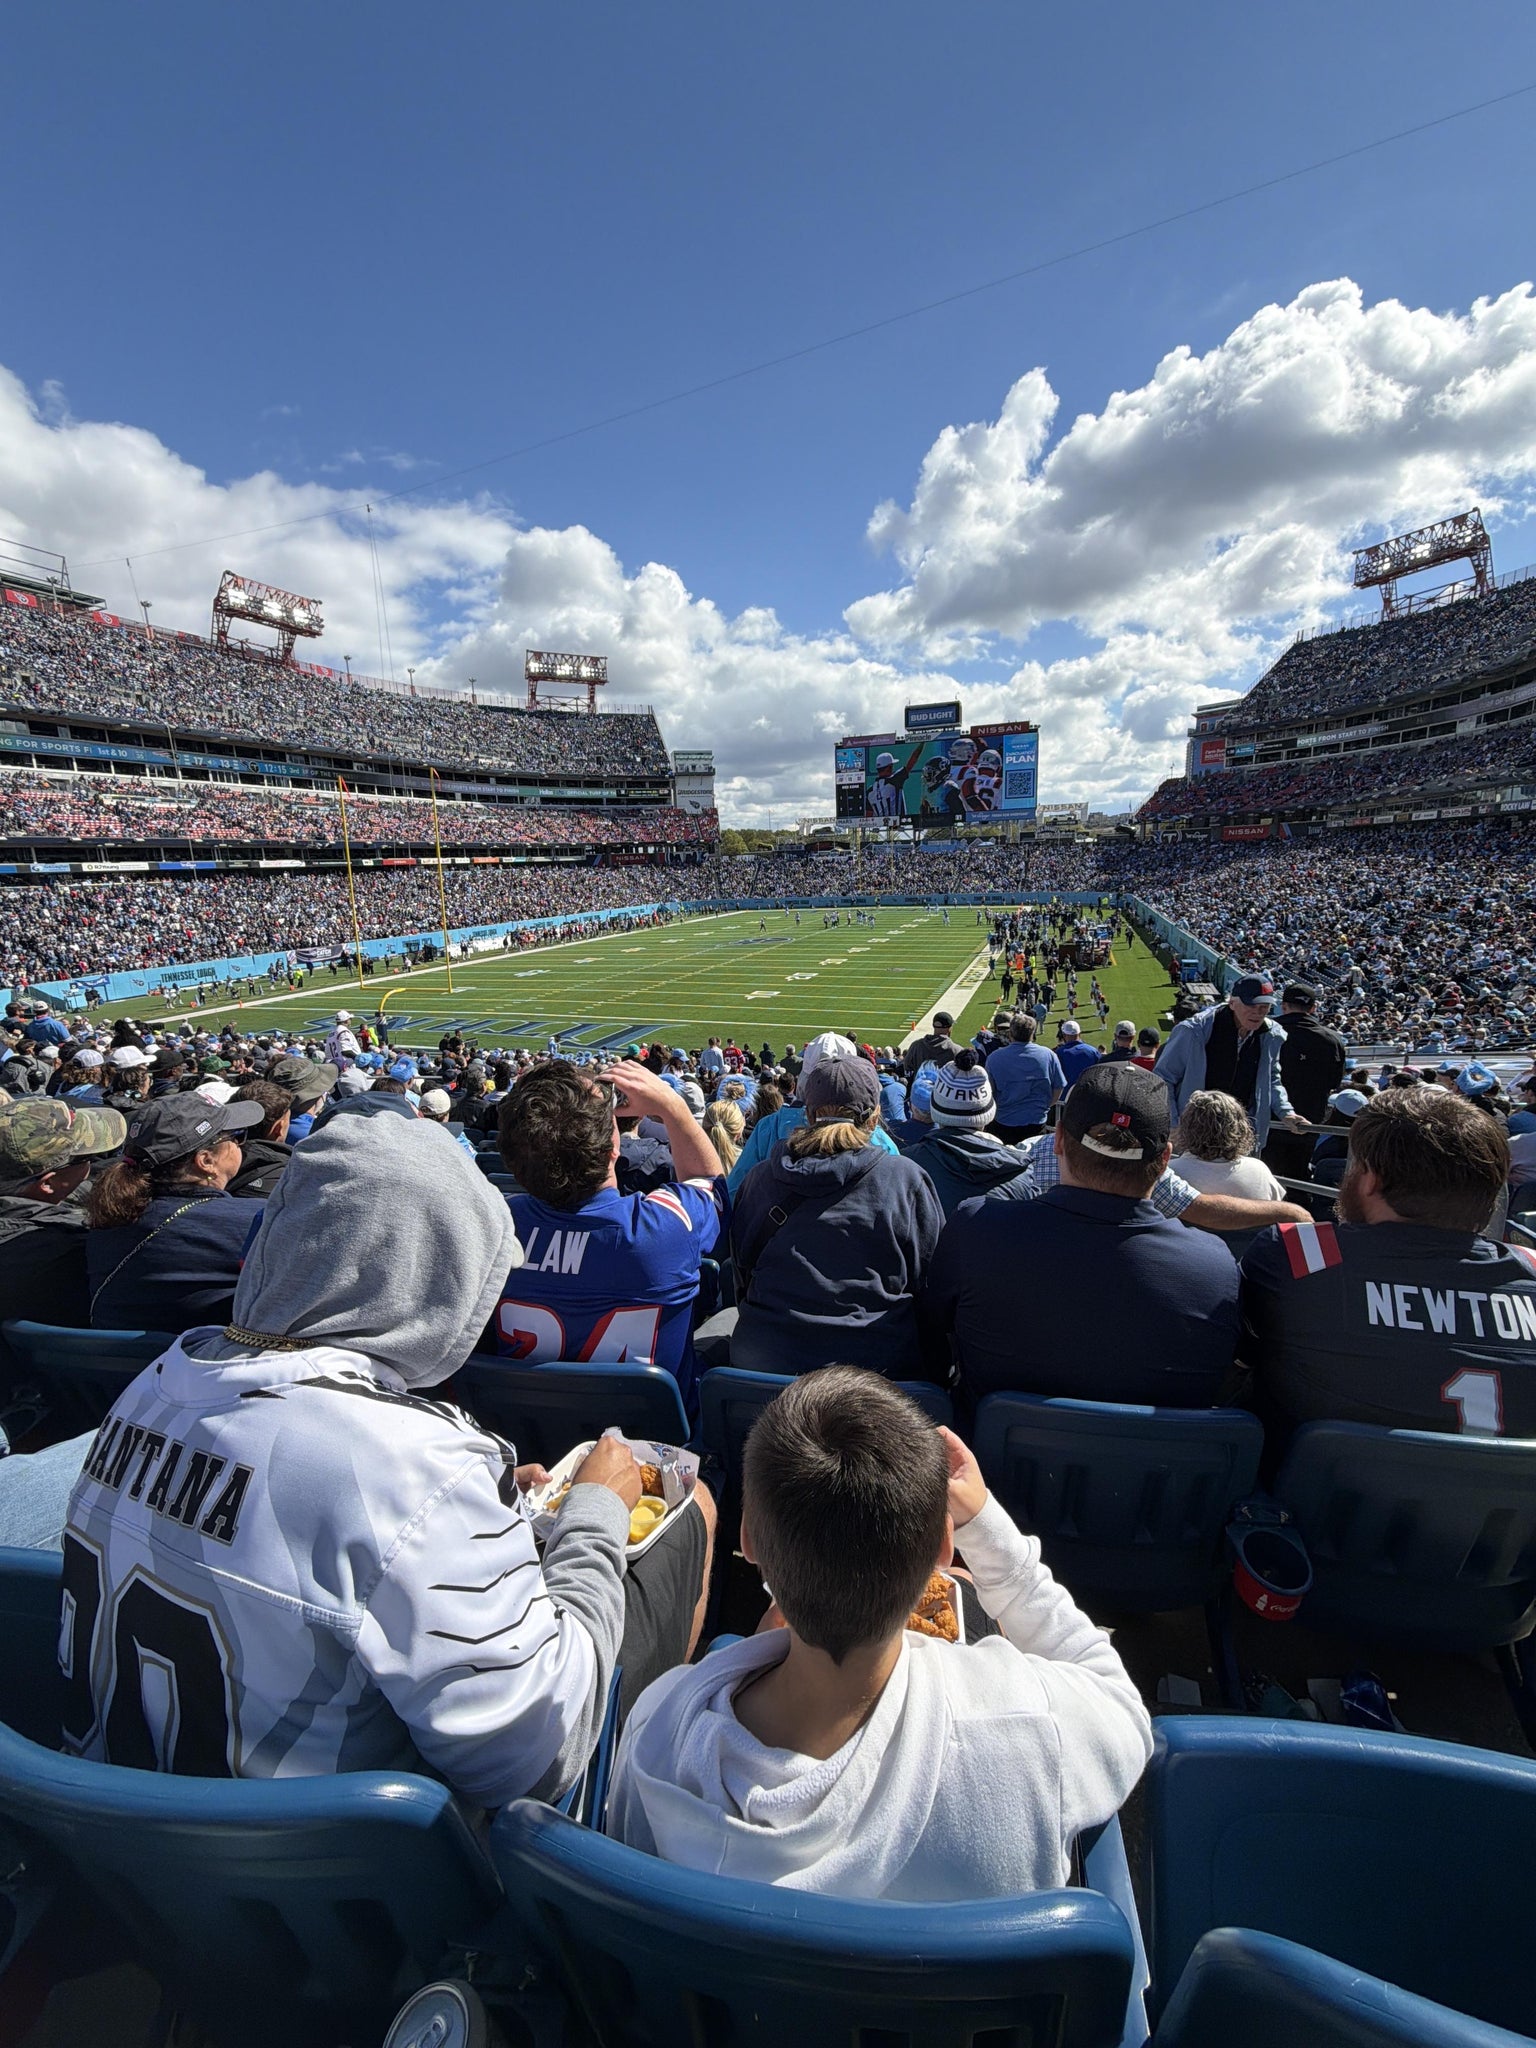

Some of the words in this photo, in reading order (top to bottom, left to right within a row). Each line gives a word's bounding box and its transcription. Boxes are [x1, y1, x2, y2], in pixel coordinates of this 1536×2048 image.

[910, 713, 928, 722] BUD
[930, 710, 953, 720] LIGHT
[977, 724, 1022, 735] NISSAN
[1318, 734, 1337, 743] FROM
[1338, 730, 1357, 739] START
[1358, 728, 1368, 736] TO
[1368, 724, 1389, 735] FINISH
[905, 734, 931, 742] Pinnacle
[16, 739, 38, 749] FOR
[41, 742, 81, 753] SPORTS
[193, 756, 204, 766] 17
[220, 759, 231, 769] 13
[1005, 754, 1035, 765] PLAN
[264, 763, 287, 775] 12:15
[289, 767, 299, 775] 3rd
[319, 770, 332, 778] THE
[1042, 803, 1081, 811] NISSAN
[1228, 828, 1264, 836] NISSAN
[316, 949, 332, 957] CATCH
[160, 970, 195, 983] TENNESSEE
[936, 1078, 988, 1101] TITANS
[521, 1226, 590, 1275] LAW
[1365, 1281, 1536, 1341] NEWTON
[1440, 1367, 1505, 1437] 1
